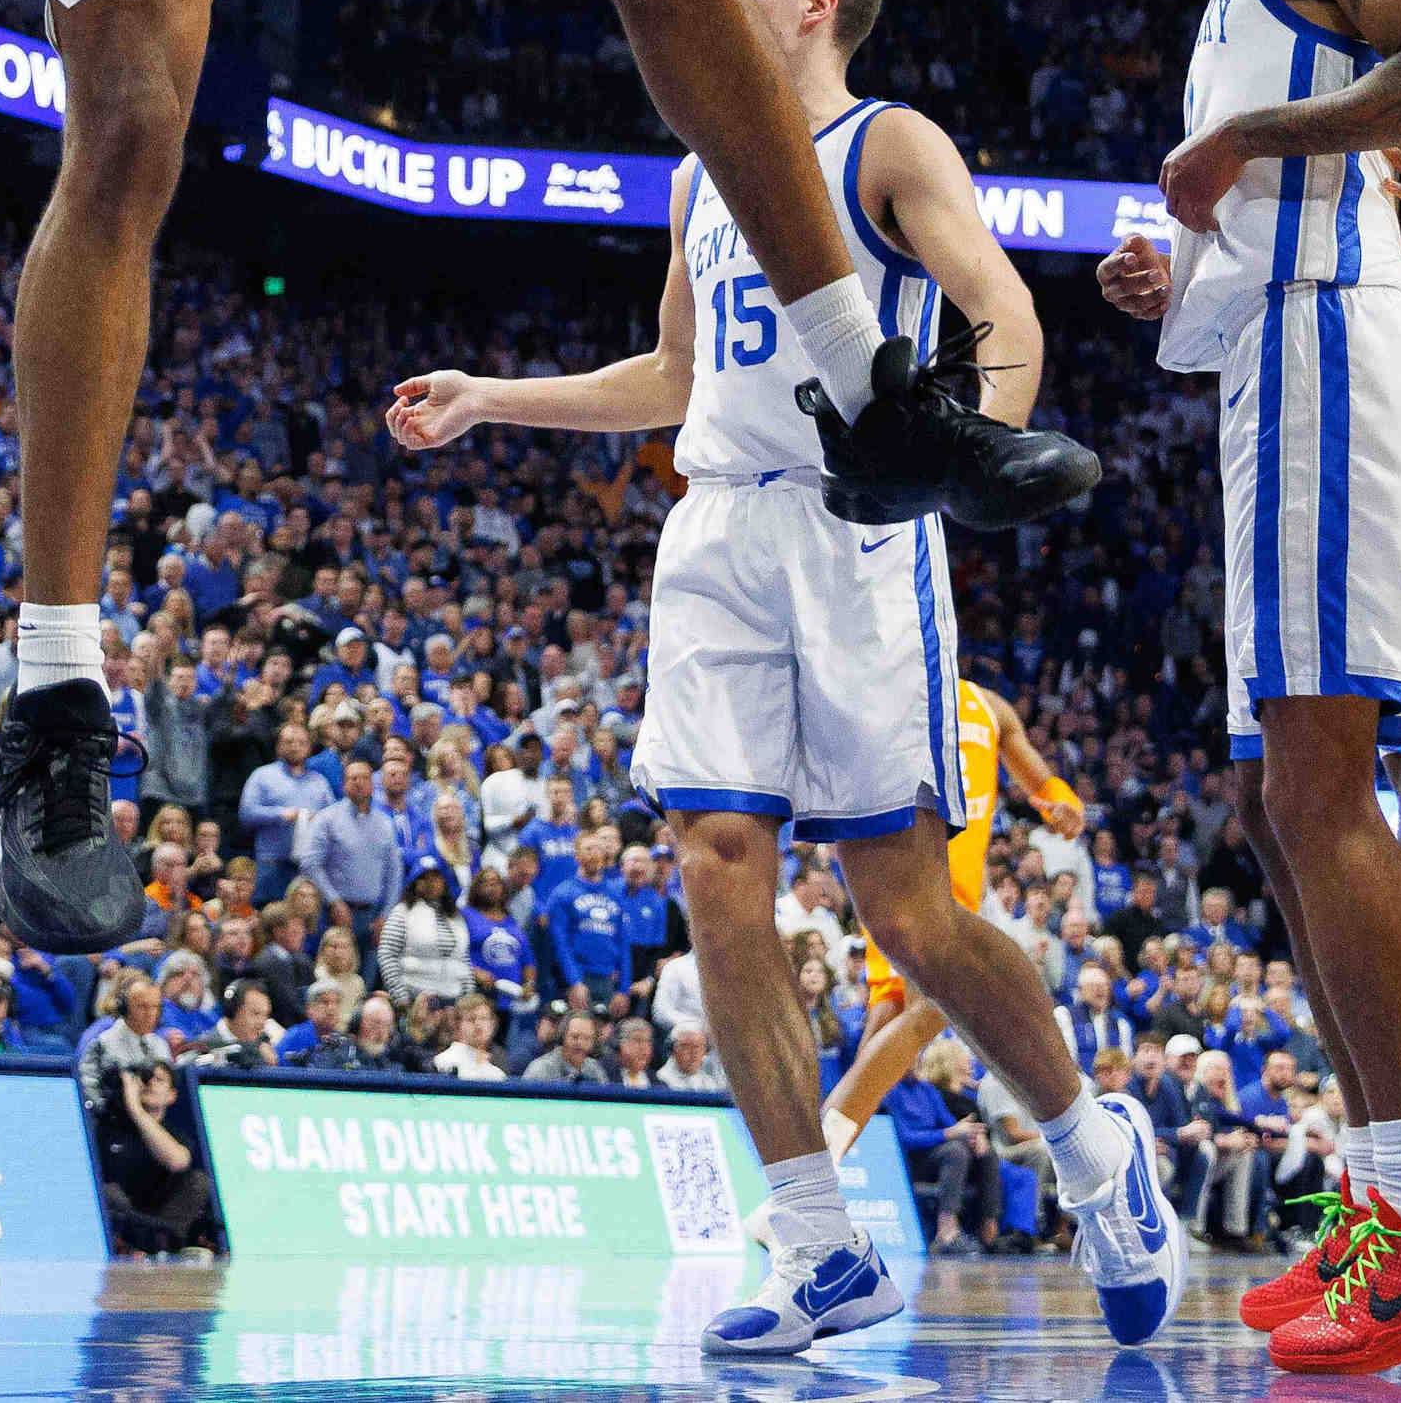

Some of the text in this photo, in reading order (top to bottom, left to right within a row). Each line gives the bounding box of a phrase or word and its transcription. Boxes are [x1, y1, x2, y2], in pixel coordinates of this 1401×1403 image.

[291, 117, 435, 204] BUCKLE
[448, 155, 527, 208] UP
[973, 185, 1065, 239] WN
[711, 272, 778, 374] 15
[239, 1115, 642, 1180] SLAM DUNK SMILES
[338, 1183, 587, 1240] START HERE
